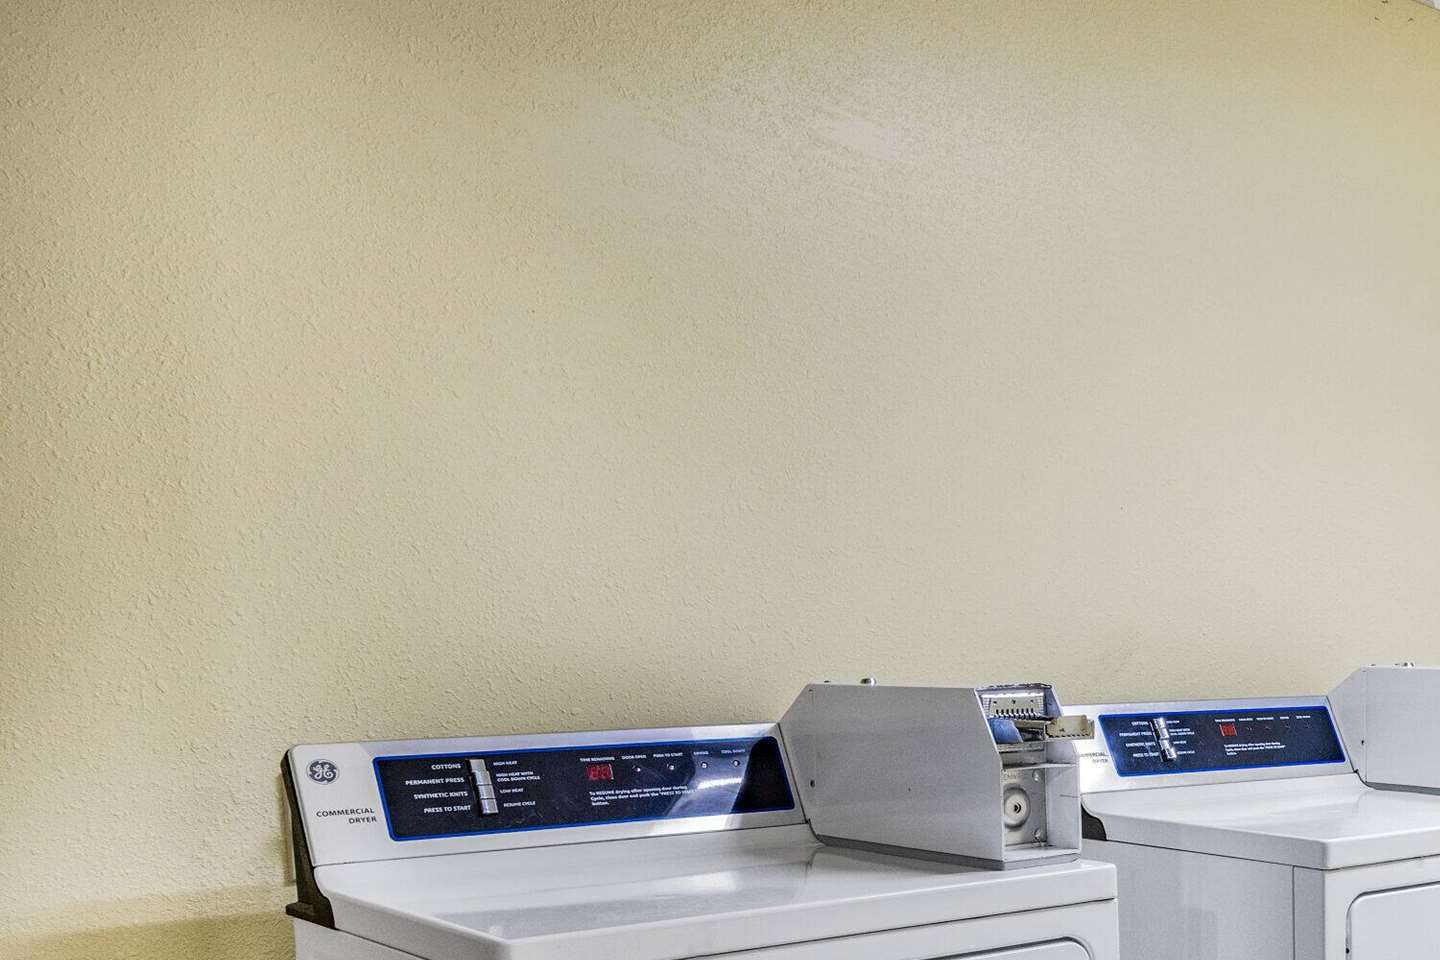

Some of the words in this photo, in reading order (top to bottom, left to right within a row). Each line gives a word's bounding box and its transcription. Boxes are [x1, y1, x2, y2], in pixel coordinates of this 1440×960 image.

[406, 778, 444, 786] PERMANENT
[316, 807, 375, 818] COMMERCIAL
[348, 816, 377, 824] DRYER
